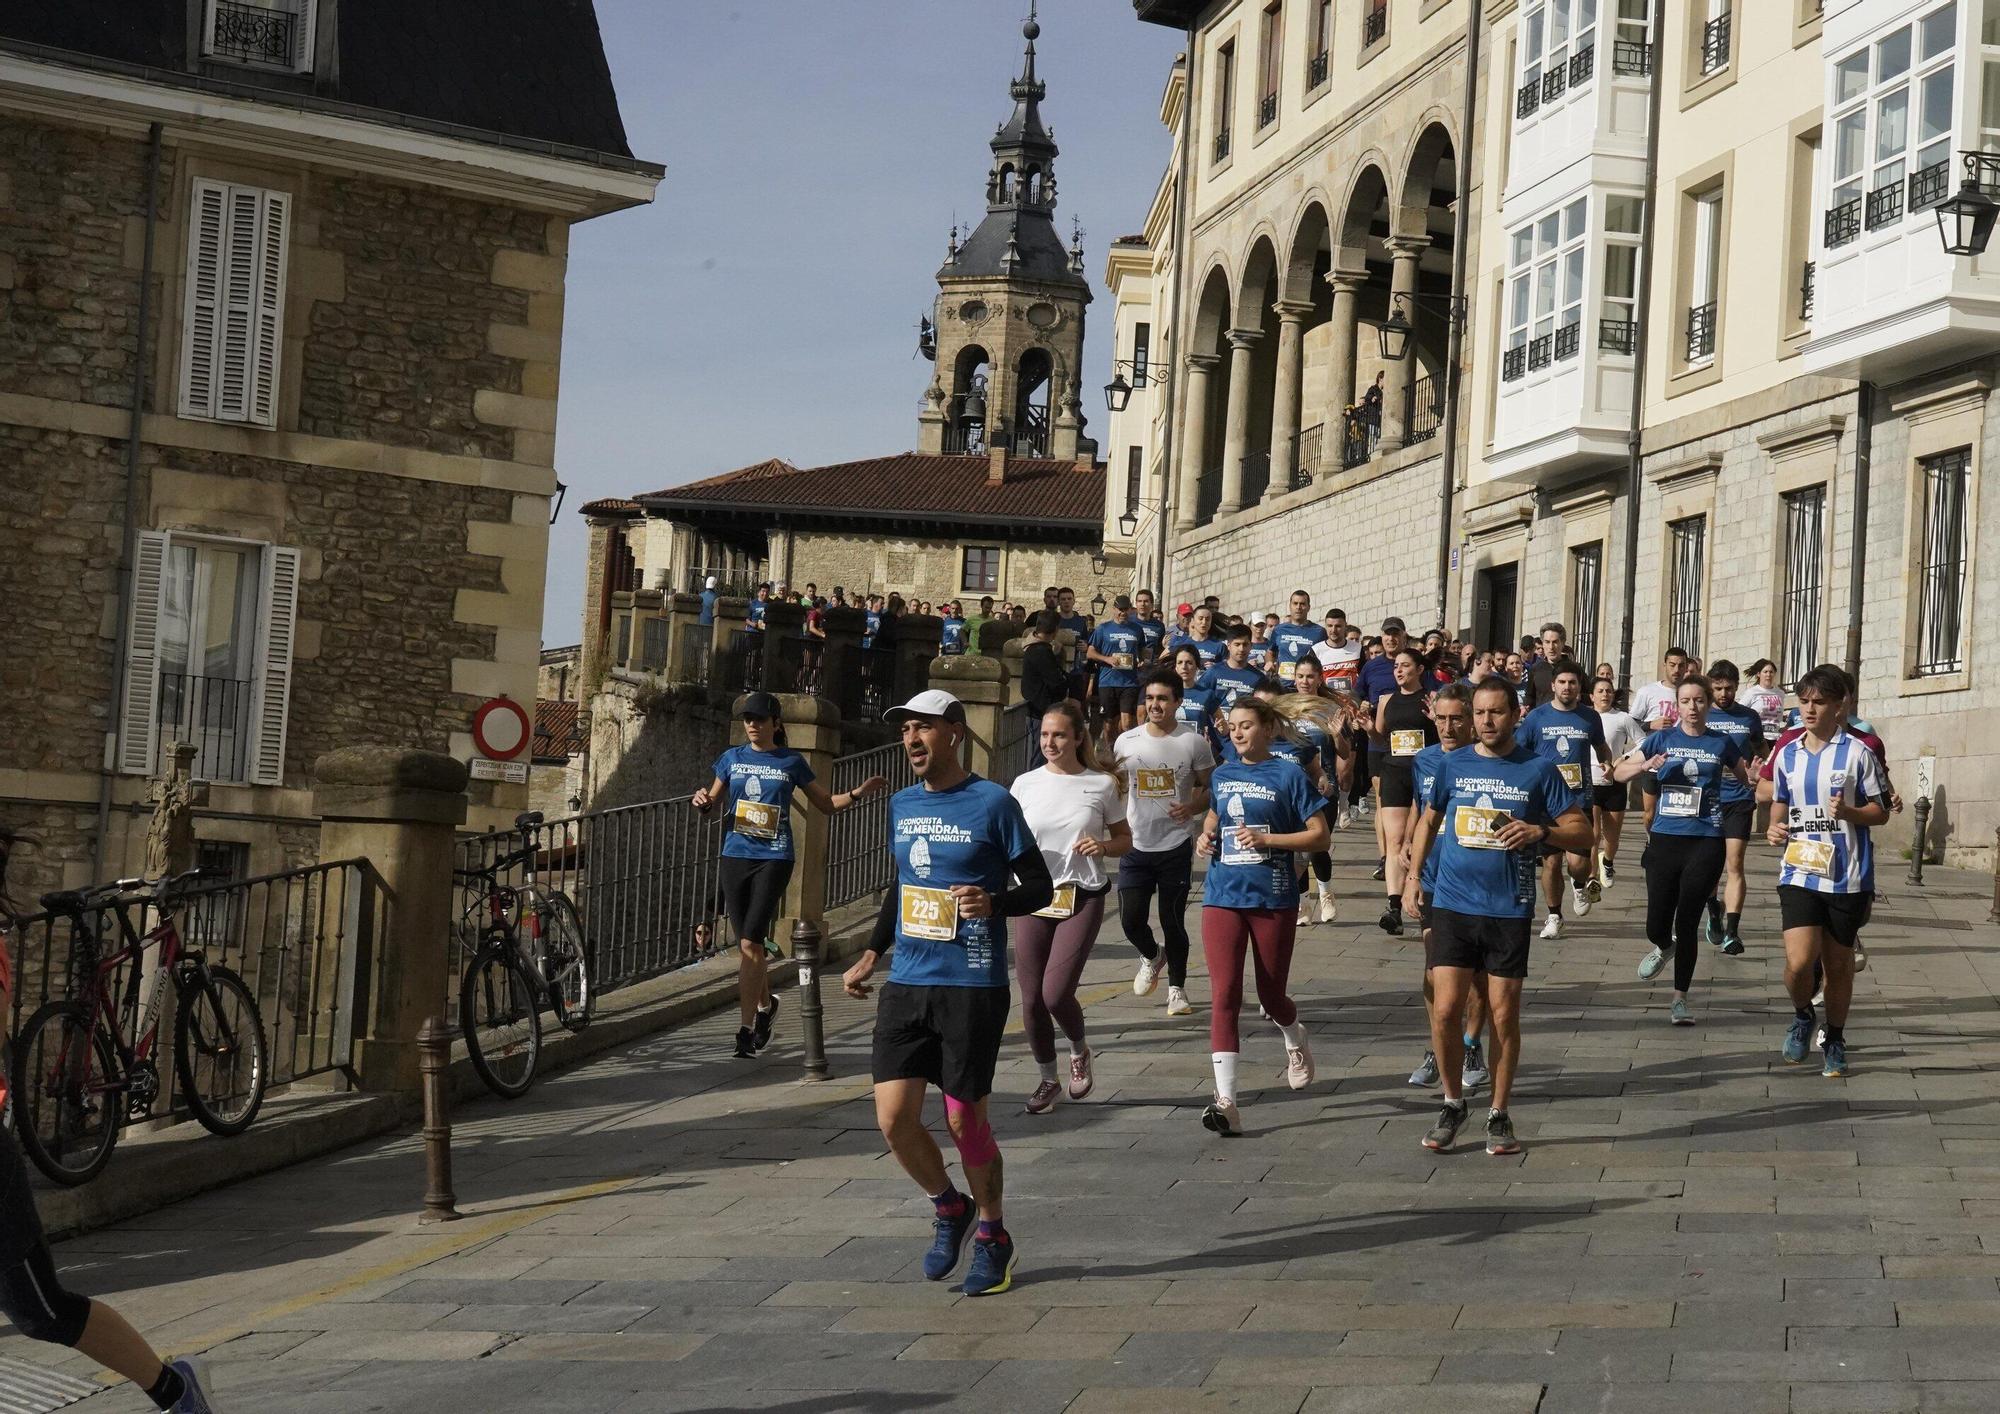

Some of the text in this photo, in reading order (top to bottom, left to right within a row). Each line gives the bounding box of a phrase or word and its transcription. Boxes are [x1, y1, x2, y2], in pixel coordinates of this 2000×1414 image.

[737, 767, 782, 775] ALMENDRA
[1147, 776, 1164, 787] 674
[1464, 777, 1505, 786] CONQUISTA
[1465, 784, 1519, 795] ALMENDRA
[1243, 792, 1276, 801] KONKISTA
[1493, 793, 1529, 802] KONKISTA
[1669, 792, 1692, 805] 1038
[746, 809, 768, 825] 669
[1815, 807, 1824, 818] LA
[903, 817, 942, 826] CONQUISTA
[1805, 820, 1841, 833] GENERAL
[902, 824, 959, 835] ALMENDRA
[929, 834, 971, 843] KONKISTA
[912, 898, 939, 920] 225
